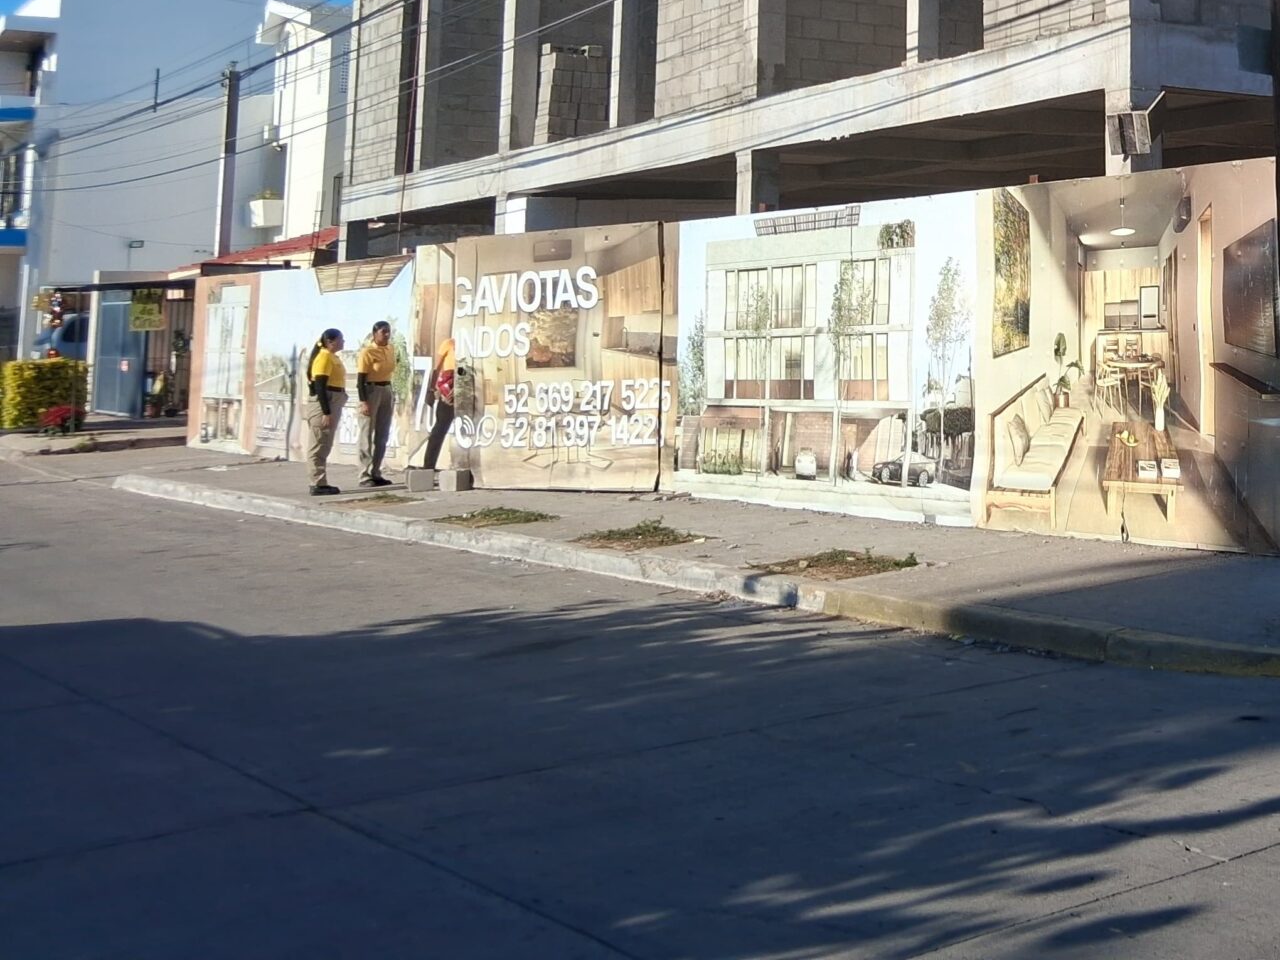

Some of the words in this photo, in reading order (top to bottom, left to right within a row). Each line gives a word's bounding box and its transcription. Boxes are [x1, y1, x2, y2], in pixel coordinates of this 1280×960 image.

[455, 266, 599, 317] GAVIOTAS
[504, 383, 528, 414] 52
[536, 382, 574, 413] 669
[580, 380, 614, 411] 217
[501, 417, 527, 448] 52
[533, 416, 557, 447] 81
[562, 415, 600, 446] 397
